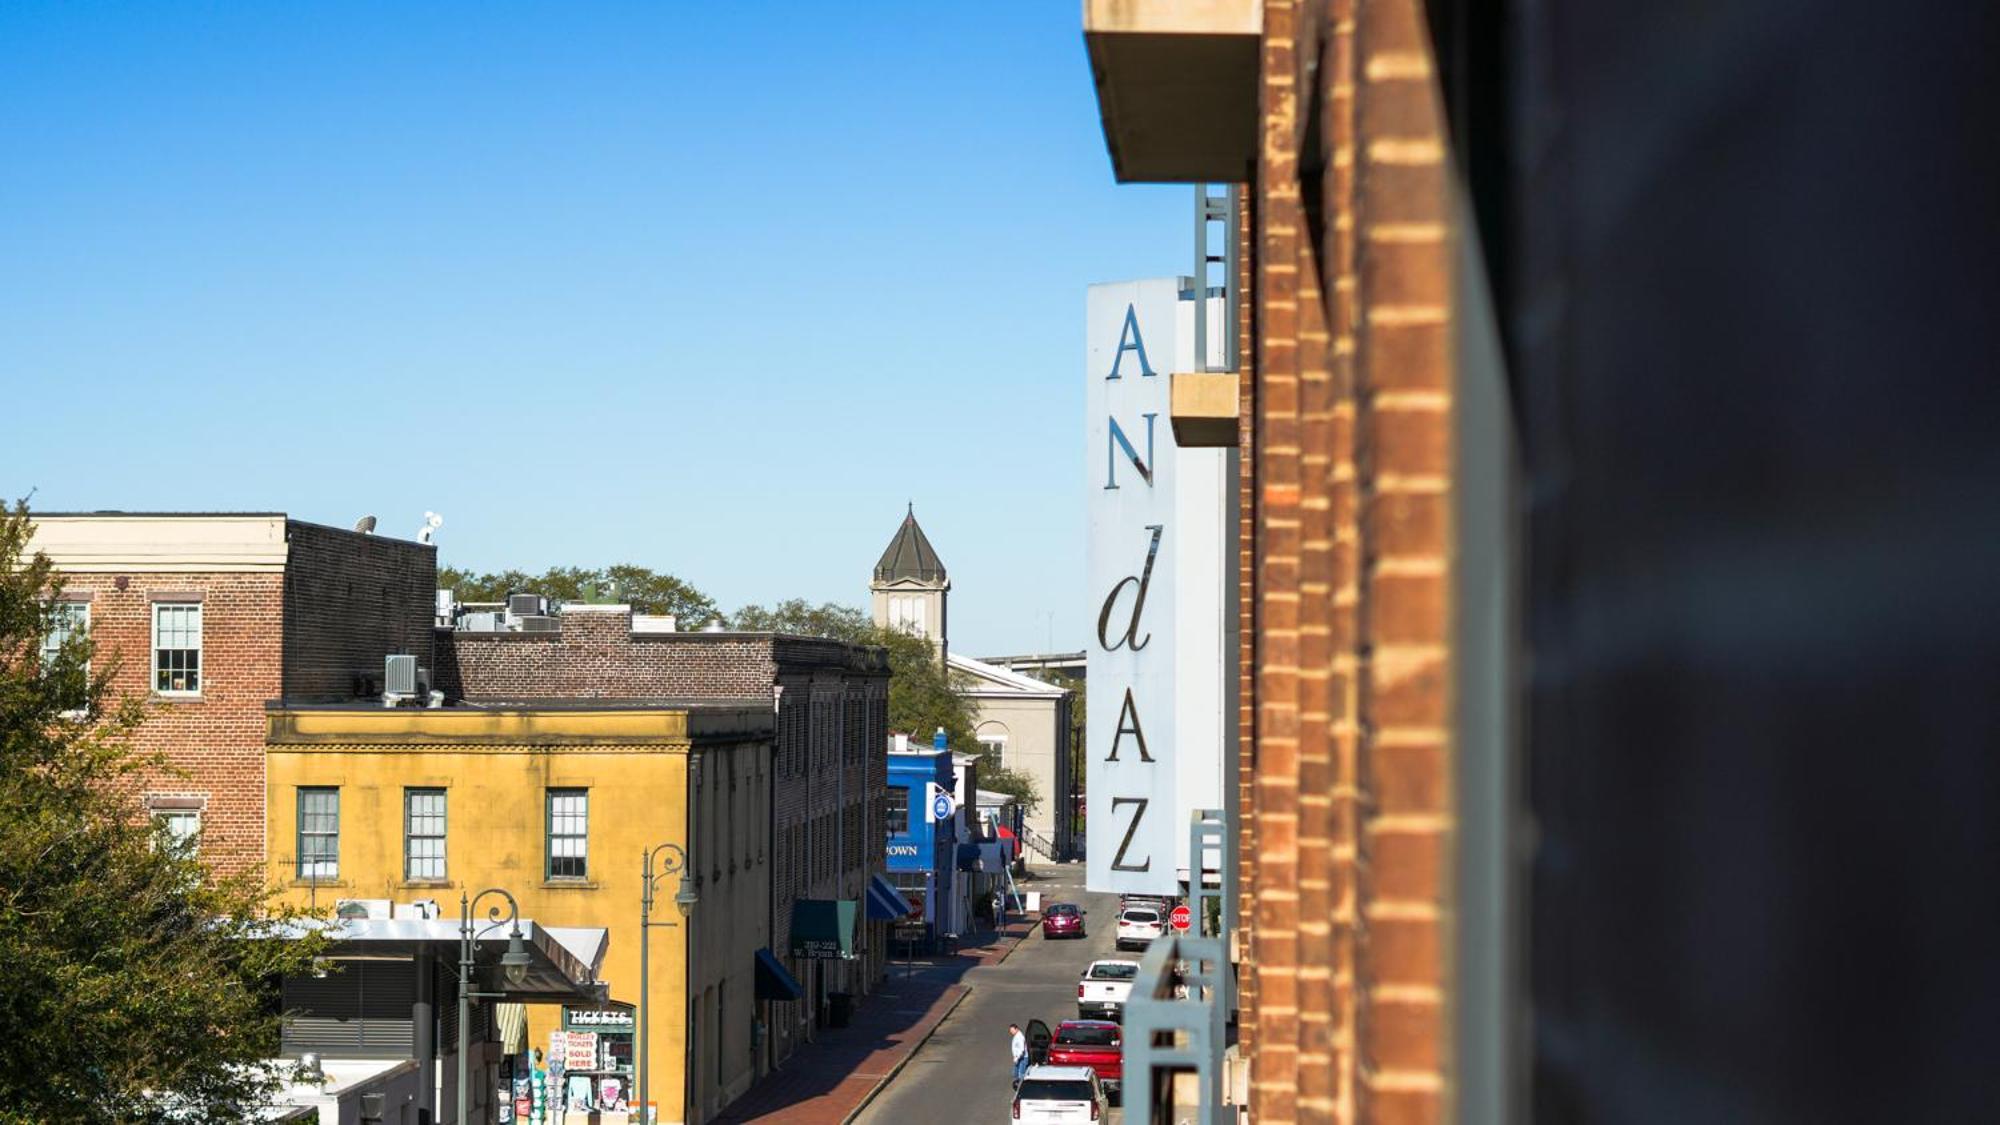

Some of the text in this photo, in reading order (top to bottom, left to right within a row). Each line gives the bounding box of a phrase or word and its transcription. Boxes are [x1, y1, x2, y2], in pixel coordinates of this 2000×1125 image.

[1097, 302, 1163, 873] ANdAZ
[886, 845, 917, 856] OWN
[1172, 913, 1190, 923] STOP
[570, 1010, 628, 1024] TICKETS
[567, 1033, 596, 1041] TROLLEY
